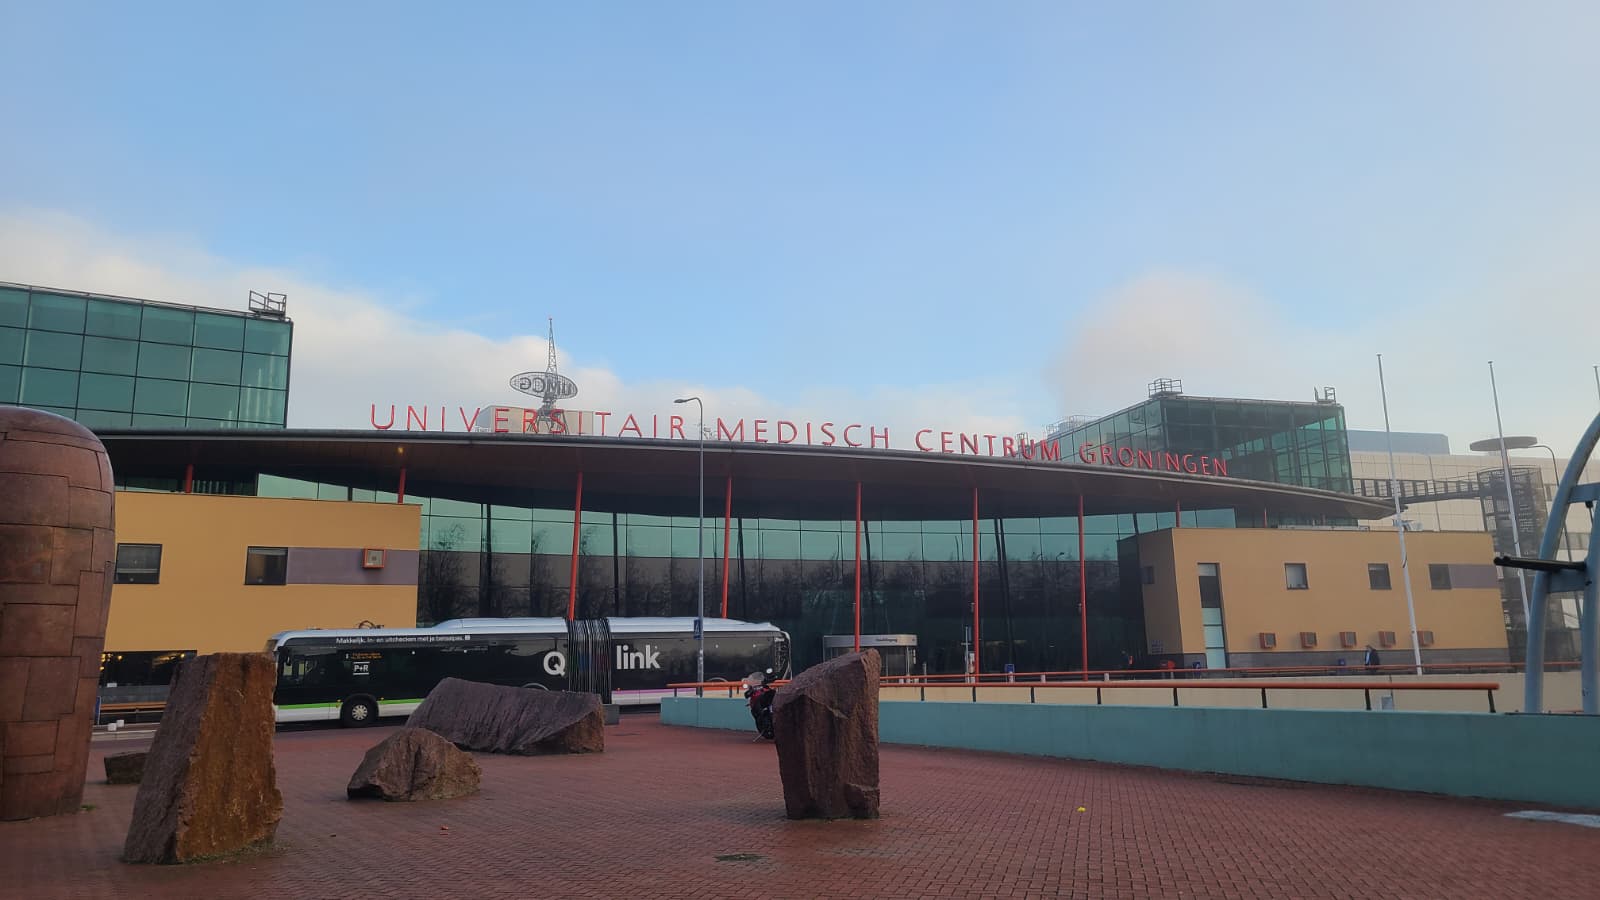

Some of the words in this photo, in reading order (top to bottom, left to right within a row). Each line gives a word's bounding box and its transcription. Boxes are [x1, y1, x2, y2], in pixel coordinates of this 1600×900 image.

[370, 404, 685, 439] UNIVERSITAIR
[717, 418, 888, 448] MEDISCH
[916, 429, 1060, 460] CENTRUM
[1079, 442, 1228, 475] GRONINGEN
[353, 664, 369, 673] P+R
[616, 644, 660, 670] link
